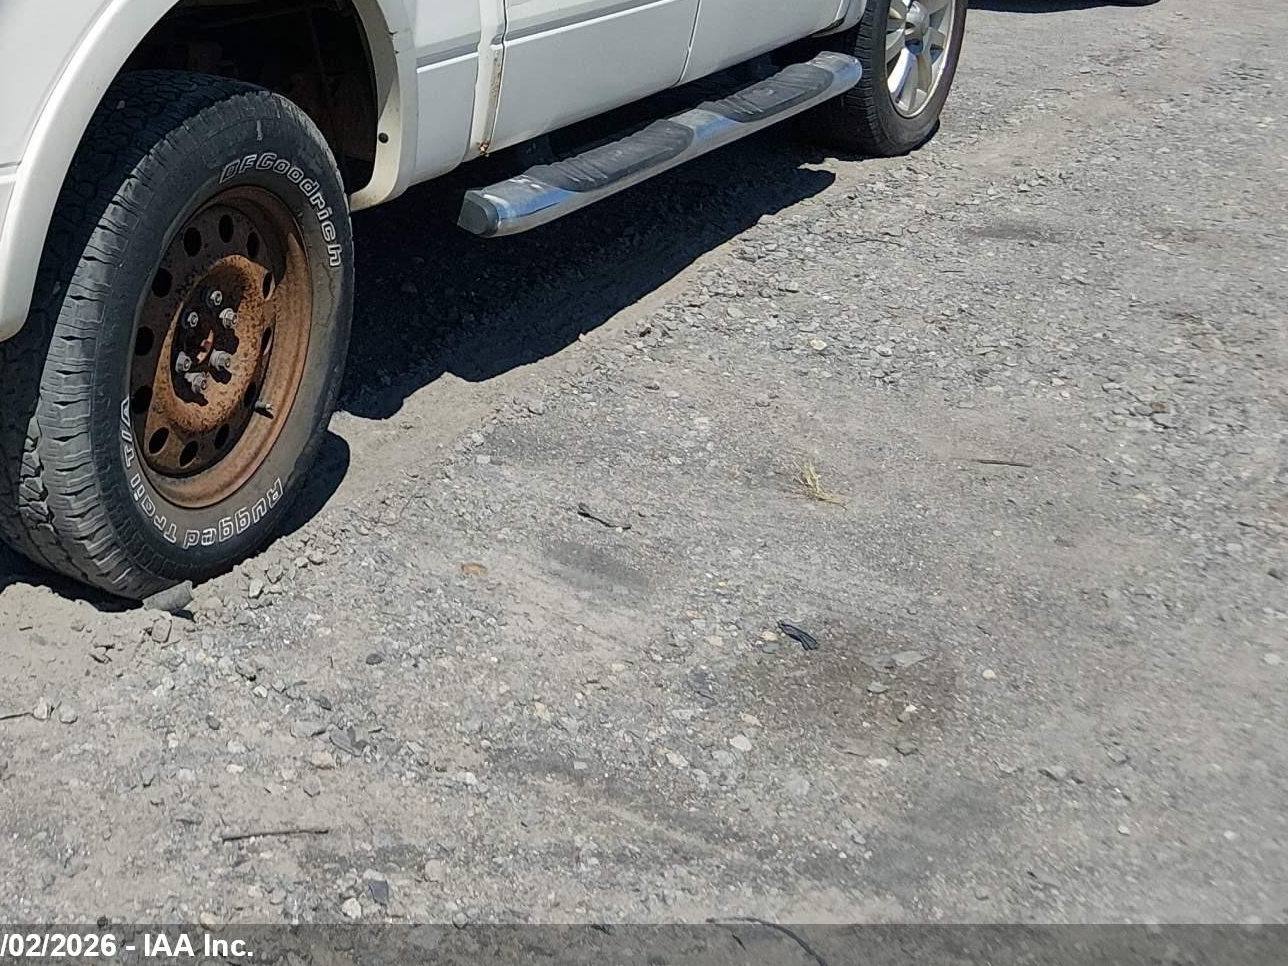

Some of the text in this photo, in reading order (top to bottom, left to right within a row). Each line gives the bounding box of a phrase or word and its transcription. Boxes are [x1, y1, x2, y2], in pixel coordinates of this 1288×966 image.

[219, 152, 342, 267] BFGoodrich
[130, 473, 177, 544] Trail
[183, 477, 285, 550] Rugged
